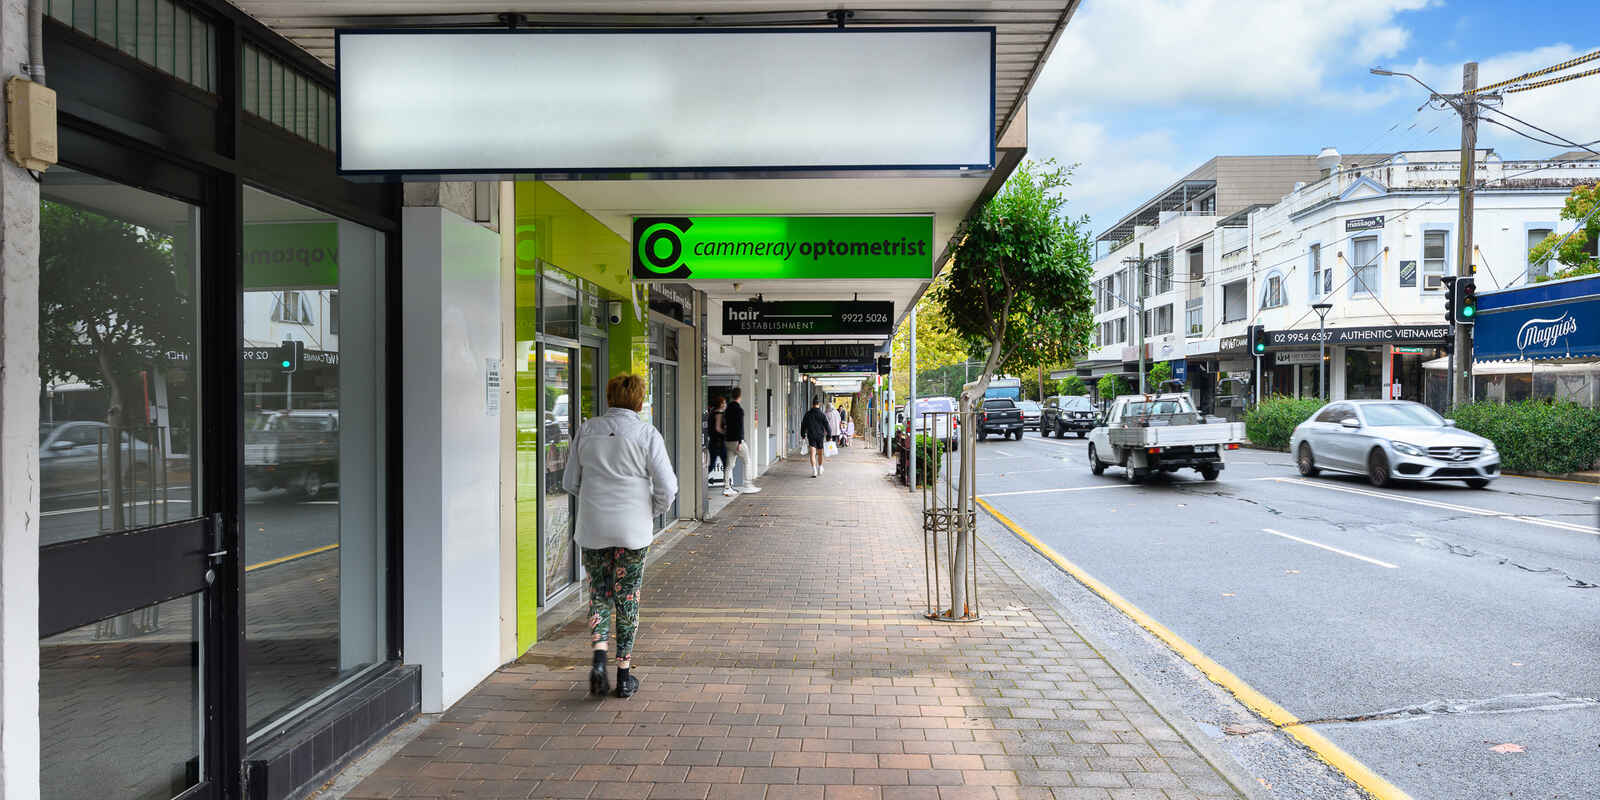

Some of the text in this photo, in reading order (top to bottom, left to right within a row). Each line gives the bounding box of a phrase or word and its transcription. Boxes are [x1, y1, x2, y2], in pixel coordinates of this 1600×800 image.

[694, 241, 797, 261] cammeray
[799, 236, 926, 261] optometrist
[728, 307, 888, 323] hair 9922 5026
[741, 321, 814, 330] ESTABLISHMENT
[1517, 311, 1577, 350] Maggio's
[1274, 334, 1286, 343] 02
[1287, 332, 1309, 342] 9954
[1340, 329, 1393, 340] AUTHENTIC
[1395, 328, 1449, 338] VIETNAMESE
